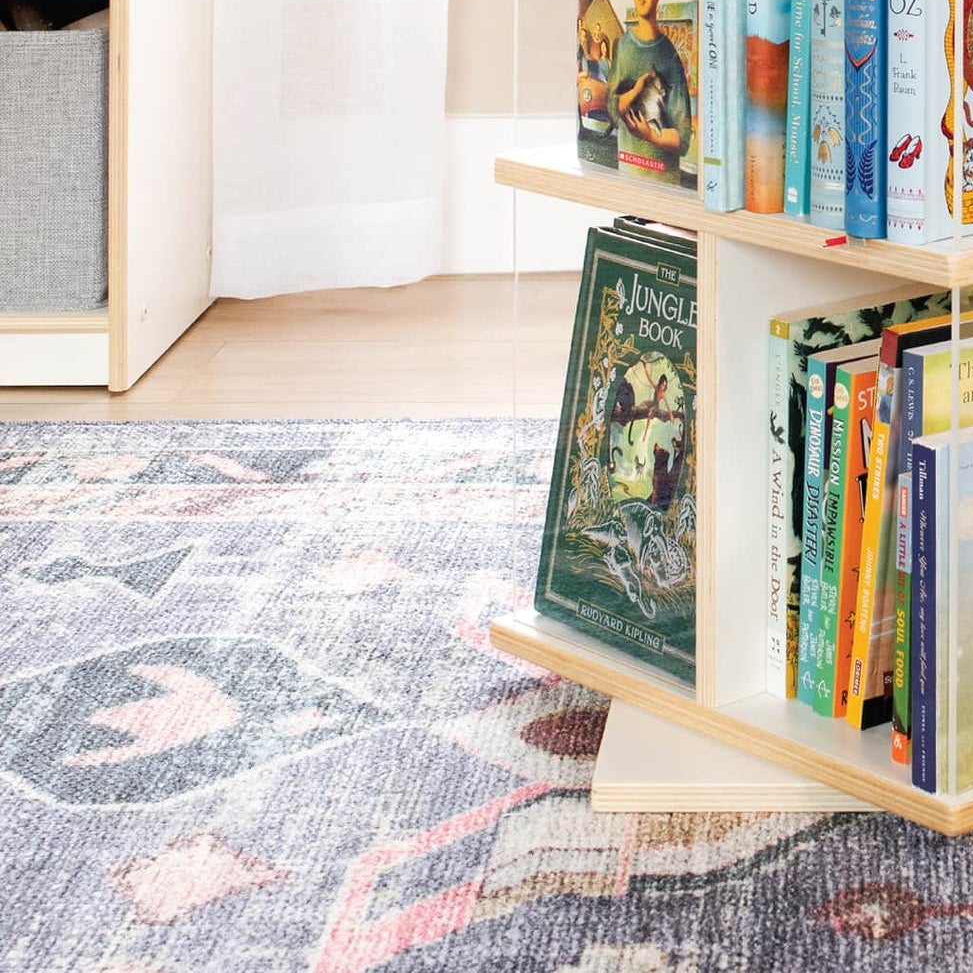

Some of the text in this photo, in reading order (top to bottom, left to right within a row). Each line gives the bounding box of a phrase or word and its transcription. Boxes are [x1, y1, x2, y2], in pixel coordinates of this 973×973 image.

[793, 30, 805, 53] for
[892, 66, 918, 80] Frank
[892, 82, 917, 97] Baum
[624, 155, 666, 171] SCHOLASTIC
[789, 113, 802, 166] Mouse!
[660, 267, 677, 282] THE
[624, 272, 698, 328] JUNGLE
[638, 317, 684, 351] BOOK
[907, 389, 916, 422] LEWIS
[808, 408, 823, 479] DINOSAUR
[830, 418, 845, 486] MISSION
[872, 432, 886, 501] TWO STRIKES
[918, 459, 928, 501] Tillman
[770, 450, 785, 623] A Wind in the Door
[824, 492, 841, 574] IMPAWSIBLE
[898, 521, 907, 568] A LITTLE
[811, 577, 821, 608] STEVEN
[581, 603, 662, 650] RUDYARD KIPLING
[895, 608, 906, 689] SOUL FOOD
